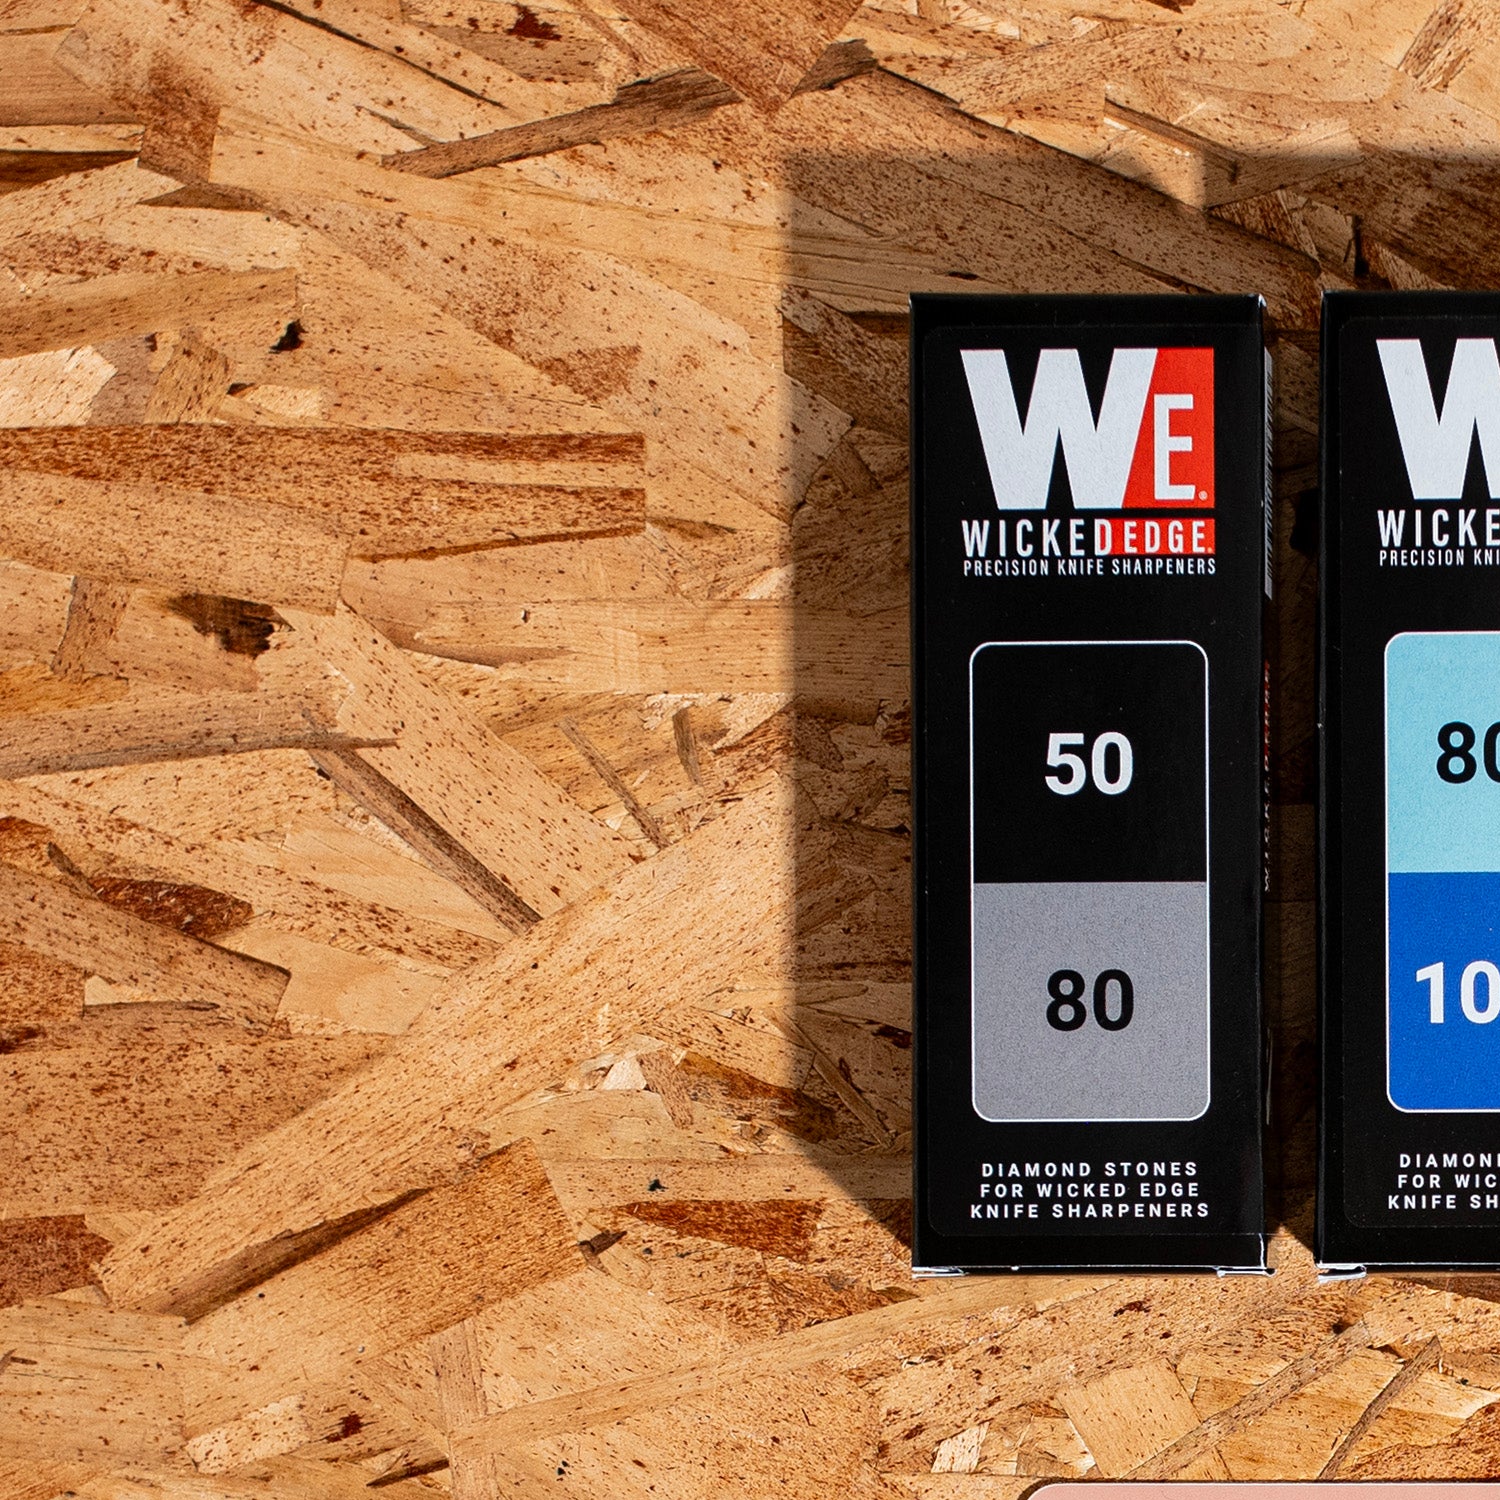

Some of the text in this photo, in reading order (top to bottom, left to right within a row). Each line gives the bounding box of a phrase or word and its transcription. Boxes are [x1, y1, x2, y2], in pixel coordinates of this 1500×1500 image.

[1380, 549, 1464, 566] PRECISION
[964, 558, 1215, 576] PRECISION KNIFE SHARPENERS
[1045, 732, 1132, 795] 50
[1046, 969, 1134, 1031] 80
[982, 1162, 1196, 1177] DIAMOND STONES
[1398, 1175, 1440, 1188] FOR
[981, 1183, 1198, 1197] FOR WICKED EDGE
[1389, 1195, 1456, 1209] KNIFE
[971, 1203, 1208, 1218] KNIFE SHARPENERS
